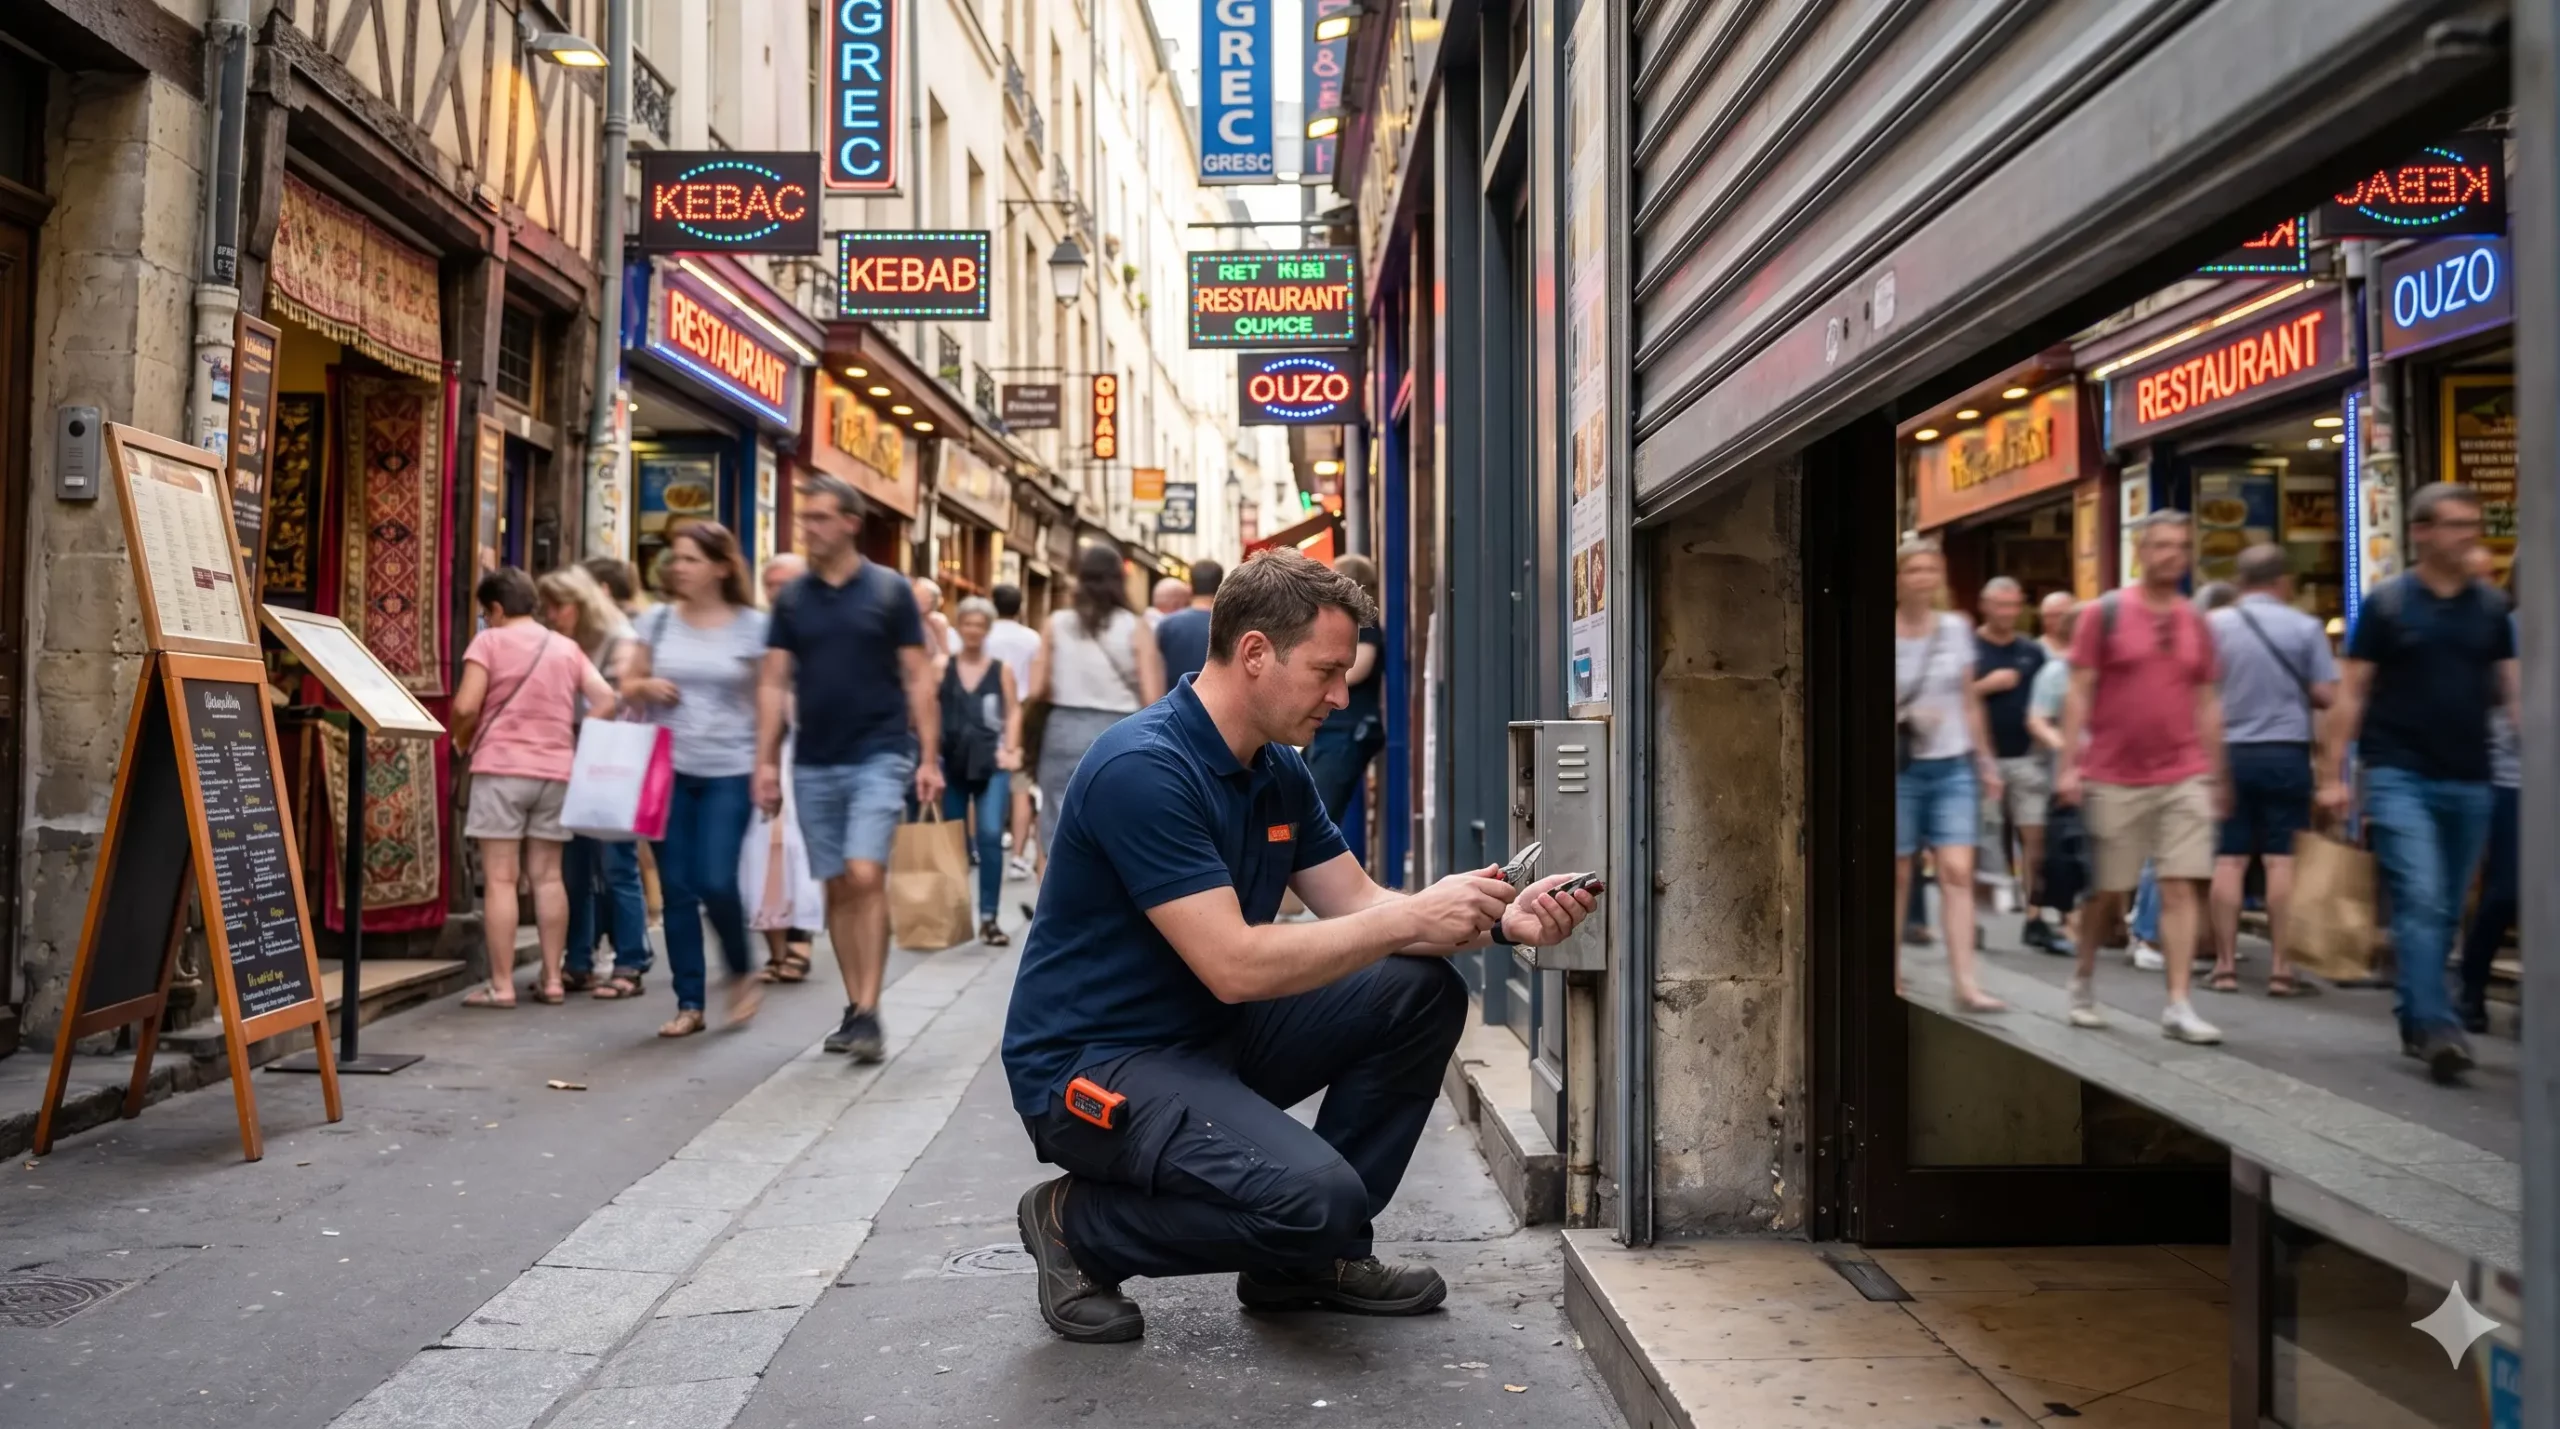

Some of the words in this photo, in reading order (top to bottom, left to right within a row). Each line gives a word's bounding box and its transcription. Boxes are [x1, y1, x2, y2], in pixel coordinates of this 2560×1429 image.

[840, 0, 884, 177] GREC
[1216, 0, 1257, 146] GREC
[1203, 153, 1272, 173] GRESC
[655, 184, 806, 221] KEBAC
[850, 257, 977, 292] KEBAB
[1218, 264, 1261, 281] RET
[2393, 247, 2495, 328] OUZO
[1198, 286, 1348, 313] RESTAURANT
[1235, 316, 1313, 334] OUMCE
[669, 290, 787, 406] RESTAURANT
[2138, 311, 2324, 424] RESTAURANT
[1249, 374, 1349, 402] OUZO
